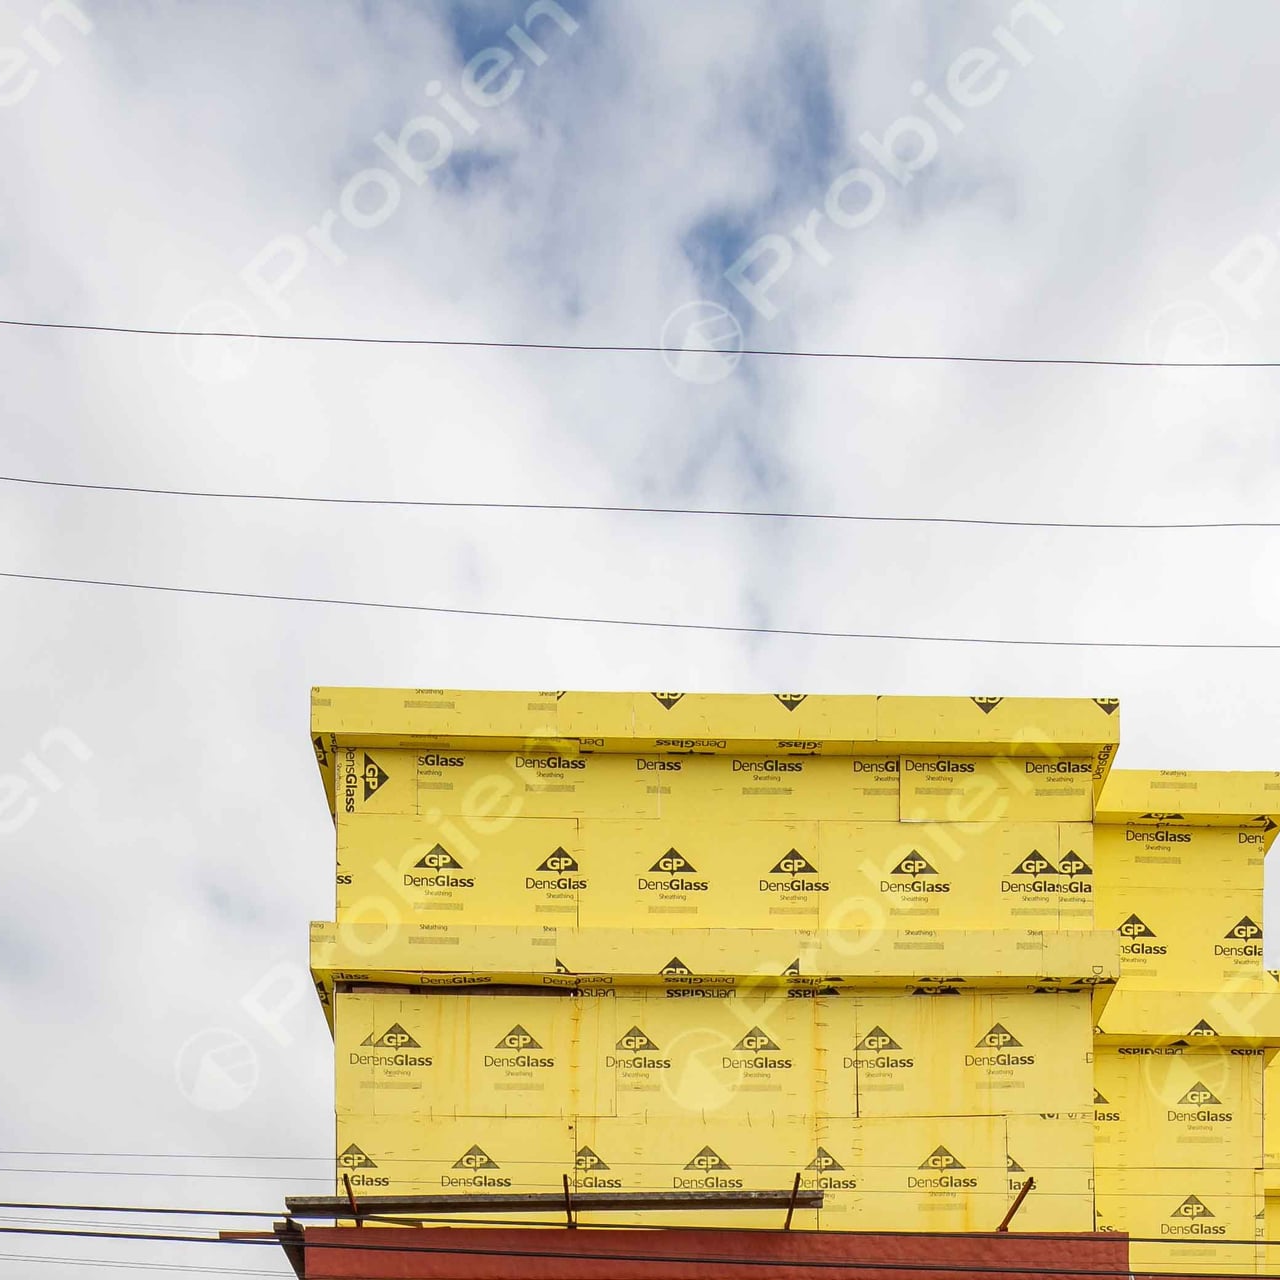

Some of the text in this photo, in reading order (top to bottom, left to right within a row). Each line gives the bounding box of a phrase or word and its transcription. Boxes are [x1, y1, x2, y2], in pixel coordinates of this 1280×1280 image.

[515, 756, 586, 769] DensGlass
[732, 760, 803, 773] DensGlass
[905, 759, 975, 773] DensGlass
[1126, 830, 1191, 843] DensGlass
[424, 854, 451, 867] GP
[546, 857, 572, 871] GP
[659, 858, 685, 871] GP
[779, 859, 806, 872] GP
[900, 860, 927, 873] GP
[1021, 860, 1048, 873] GP
[404, 874, 474, 888] DensGlass
[638, 878, 708, 891] DensGlass
[760, 880, 829, 892] DensGlass
[880, 881, 950, 893] DensGlass
[1120, 923, 1146, 936] GP
[1233, 926, 1258, 938] GP
[383, 1034, 409, 1047] GP
[505, 1035, 531, 1048] GP
[621, 1036, 648, 1049] GP
[742, 1036, 768, 1049] GP
[865, 1036, 891, 1048] GP
[985, 1033, 1012, 1046] GP
[484, 1055, 554, 1067] DensGlass
[722, 1057, 792, 1069] DensGlass
[965, 1054, 1035, 1066] DensGlass
[1186, 1091, 1211, 1103] GP
[1168, 1110, 1232, 1122] DensGlass
[339, 1154, 366, 1167] GP
[462, 1154, 488, 1168] GP
[693, 1156, 720, 1169] GP
[928, 1155, 954, 1168] GP
[441, 1175, 512, 1187] DensGlass
[673, 1177, 743, 1189] DensGlass
[907, 1176, 978, 1188] DensGlass
[1180, 1204, 1205, 1217] GP
[1161, 1223, 1226, 1235] DensGlass
